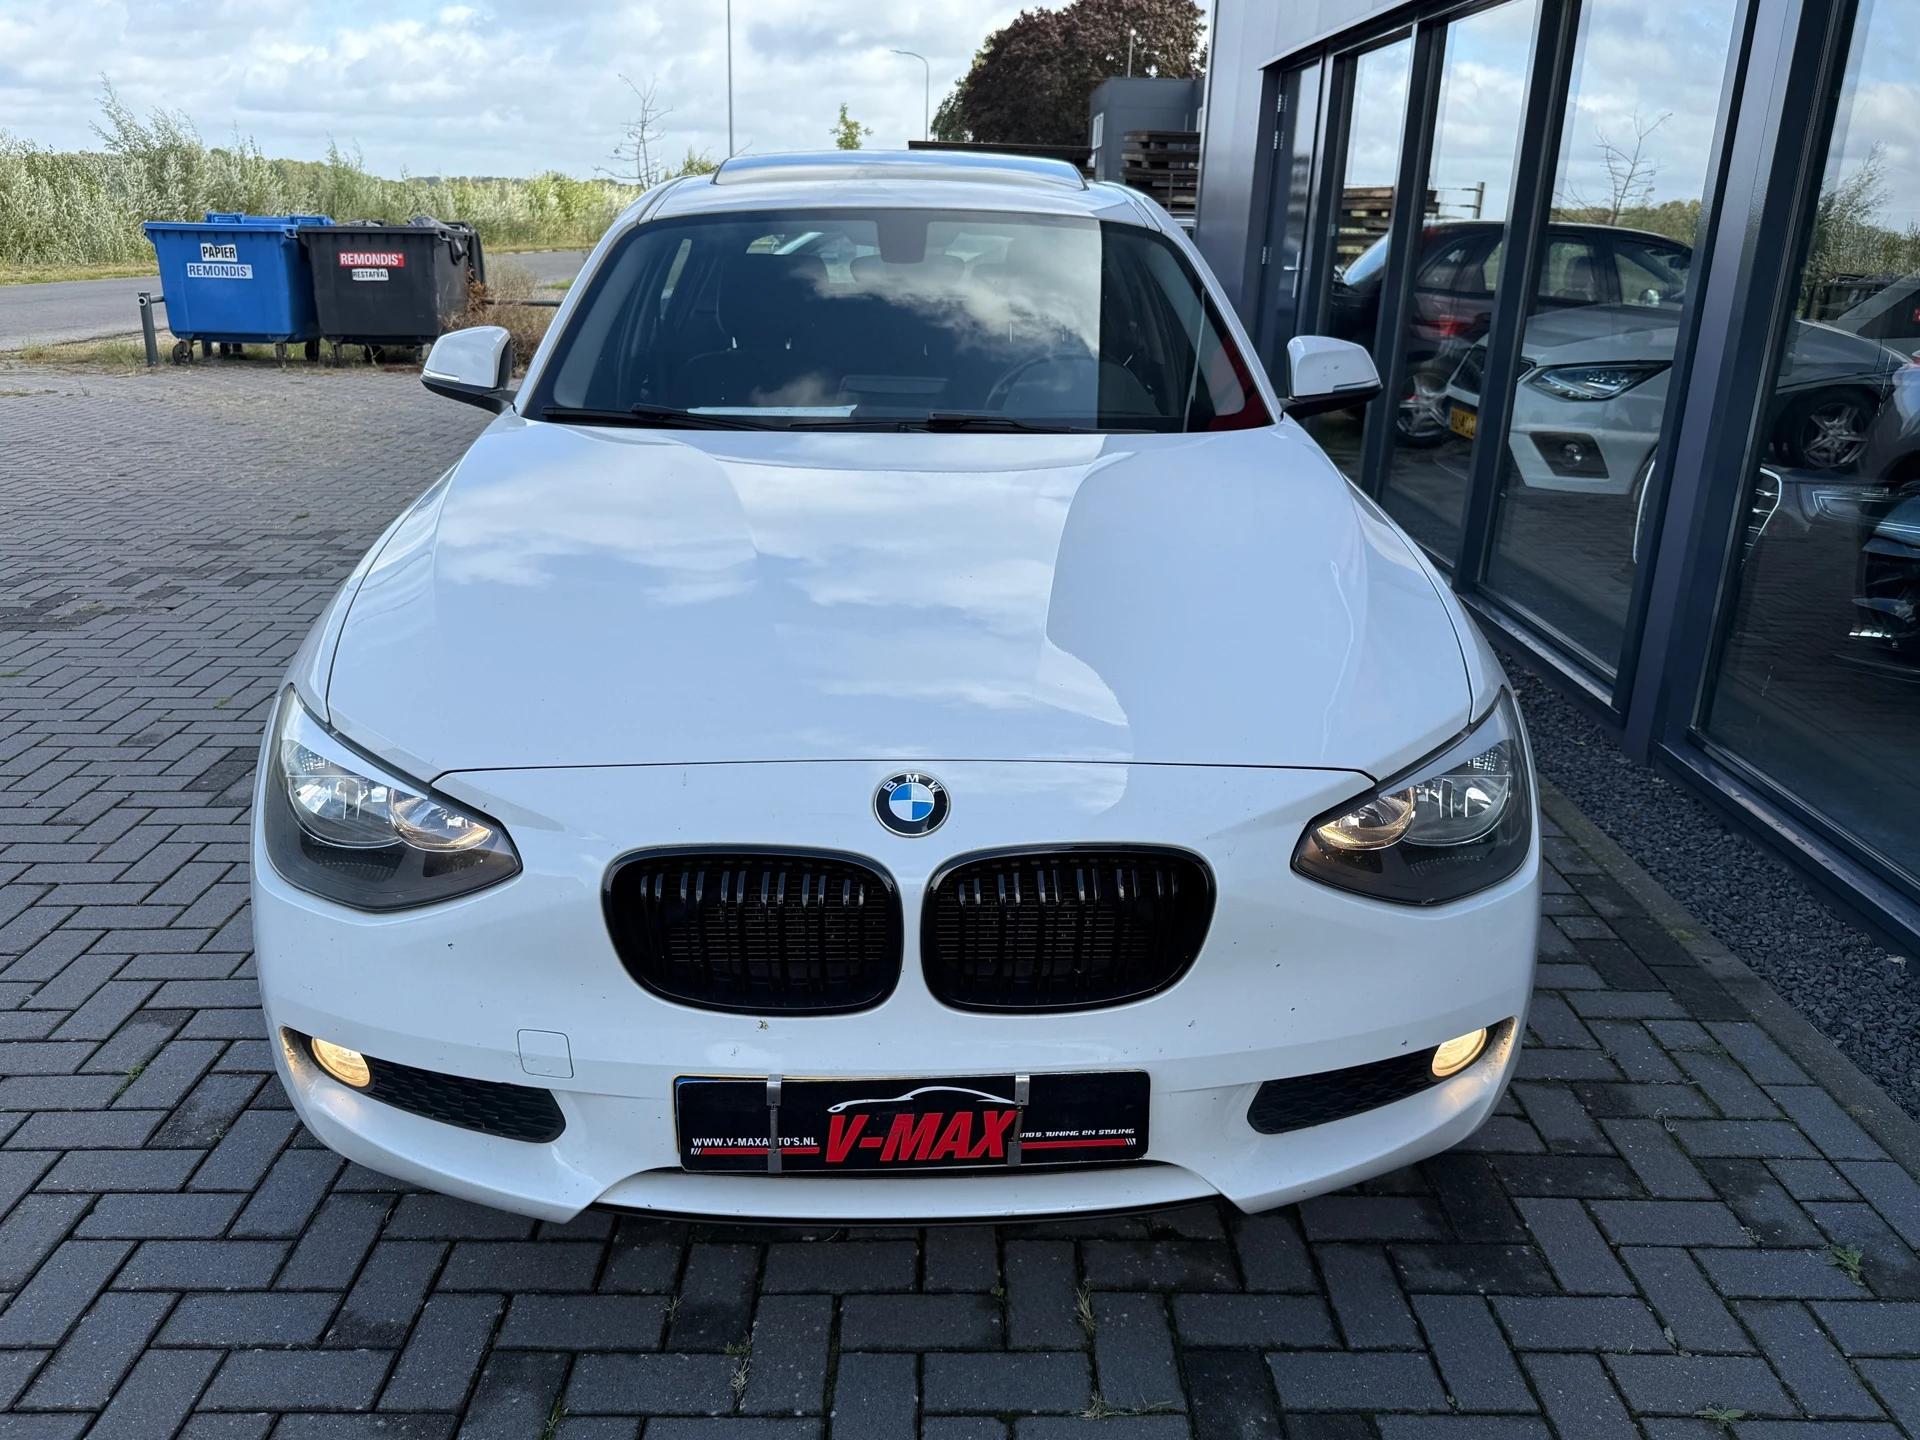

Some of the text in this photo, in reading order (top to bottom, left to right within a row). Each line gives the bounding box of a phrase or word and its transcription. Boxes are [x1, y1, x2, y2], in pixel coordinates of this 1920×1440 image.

[202, 246, 236, 259] PAPIER
[340, 253, 399, 266] REMONDIS
[188, 264, 247, 277] REMONDIS
[883, 774, 942, 793] BMW
[825, 1110, 1018, 1163] V-MAX
[1098, 1127, 1135, 1135] STYLING
[692, 1136, 818, 1147] WWW.V-MAXATO'S.NL
